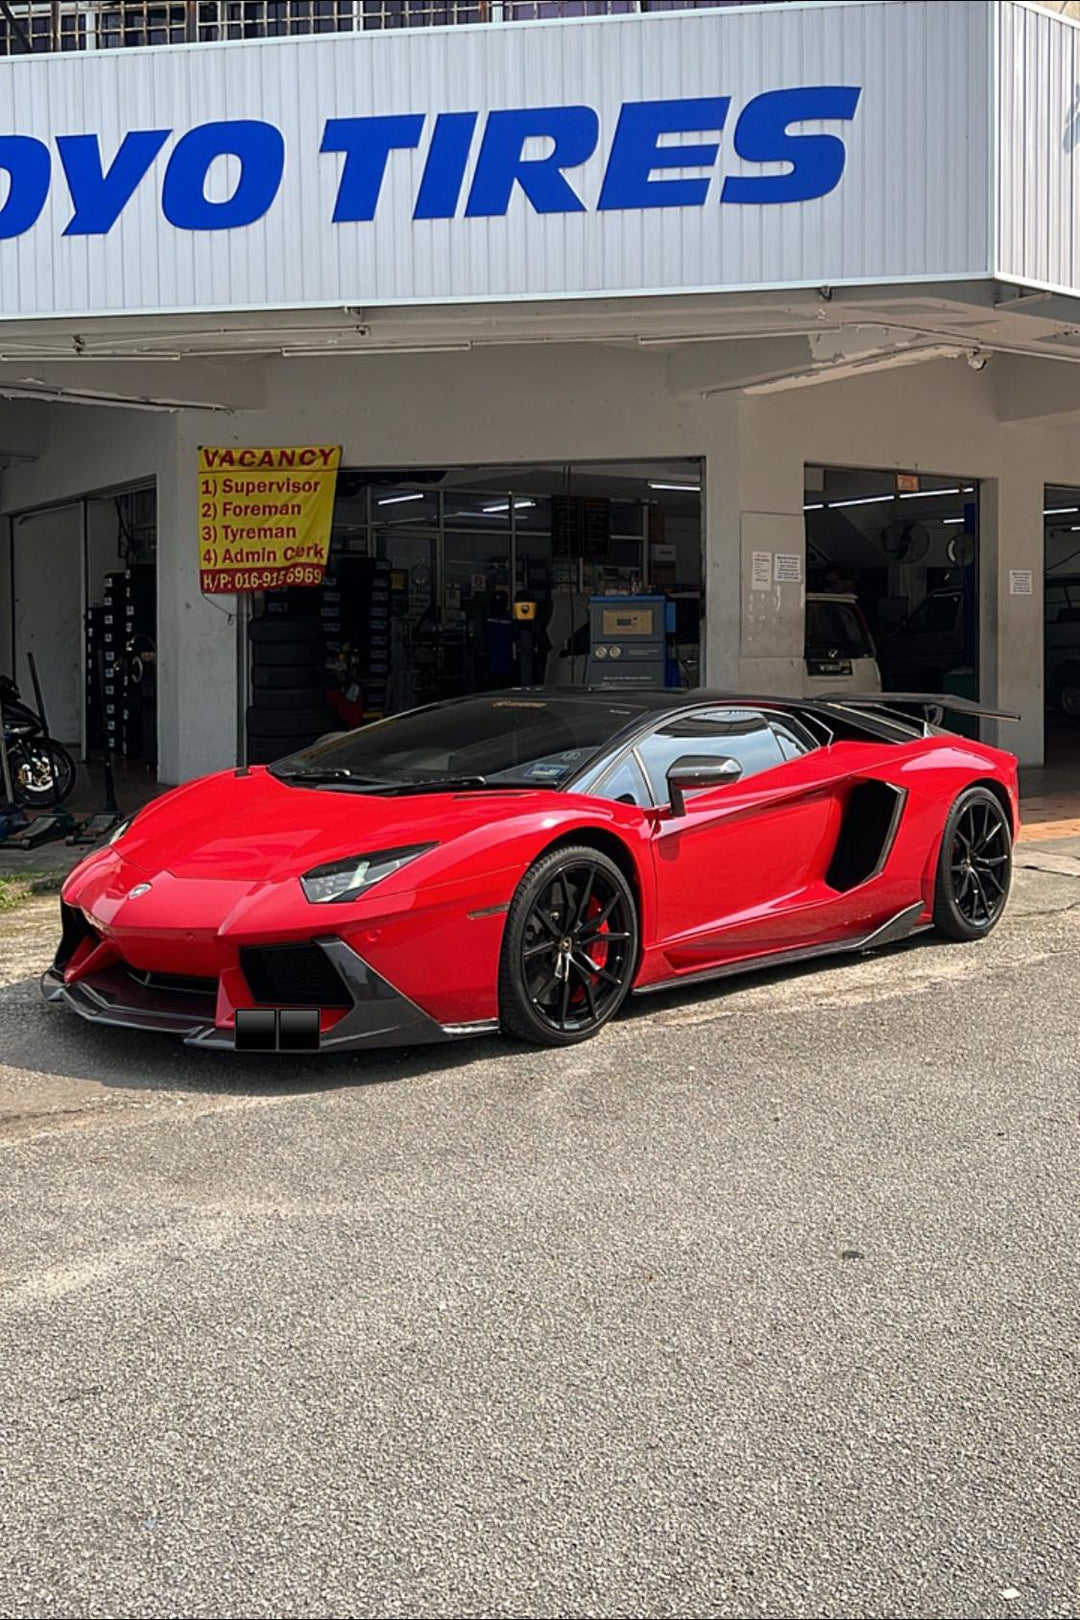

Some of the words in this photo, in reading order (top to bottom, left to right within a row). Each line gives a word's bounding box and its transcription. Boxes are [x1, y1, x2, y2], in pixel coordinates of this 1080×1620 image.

[319, 86, 861, 223] TIRES
[203, 448, 336, 468] VACANCY
[201, 479, 218, 497] 1)
[222, 477, 321, 496] Supervisor
[201, 502, 218, 521] 2)
[222, 502, 302, 517] Foreman
[202, 526, 218, 543] 3)
[222, 525, 297, 543] Tyreman
[203, 548, 218, 567] 4)
[222, 546, 277, 563] Admin
[203, 573, 232, 592] H/P:
